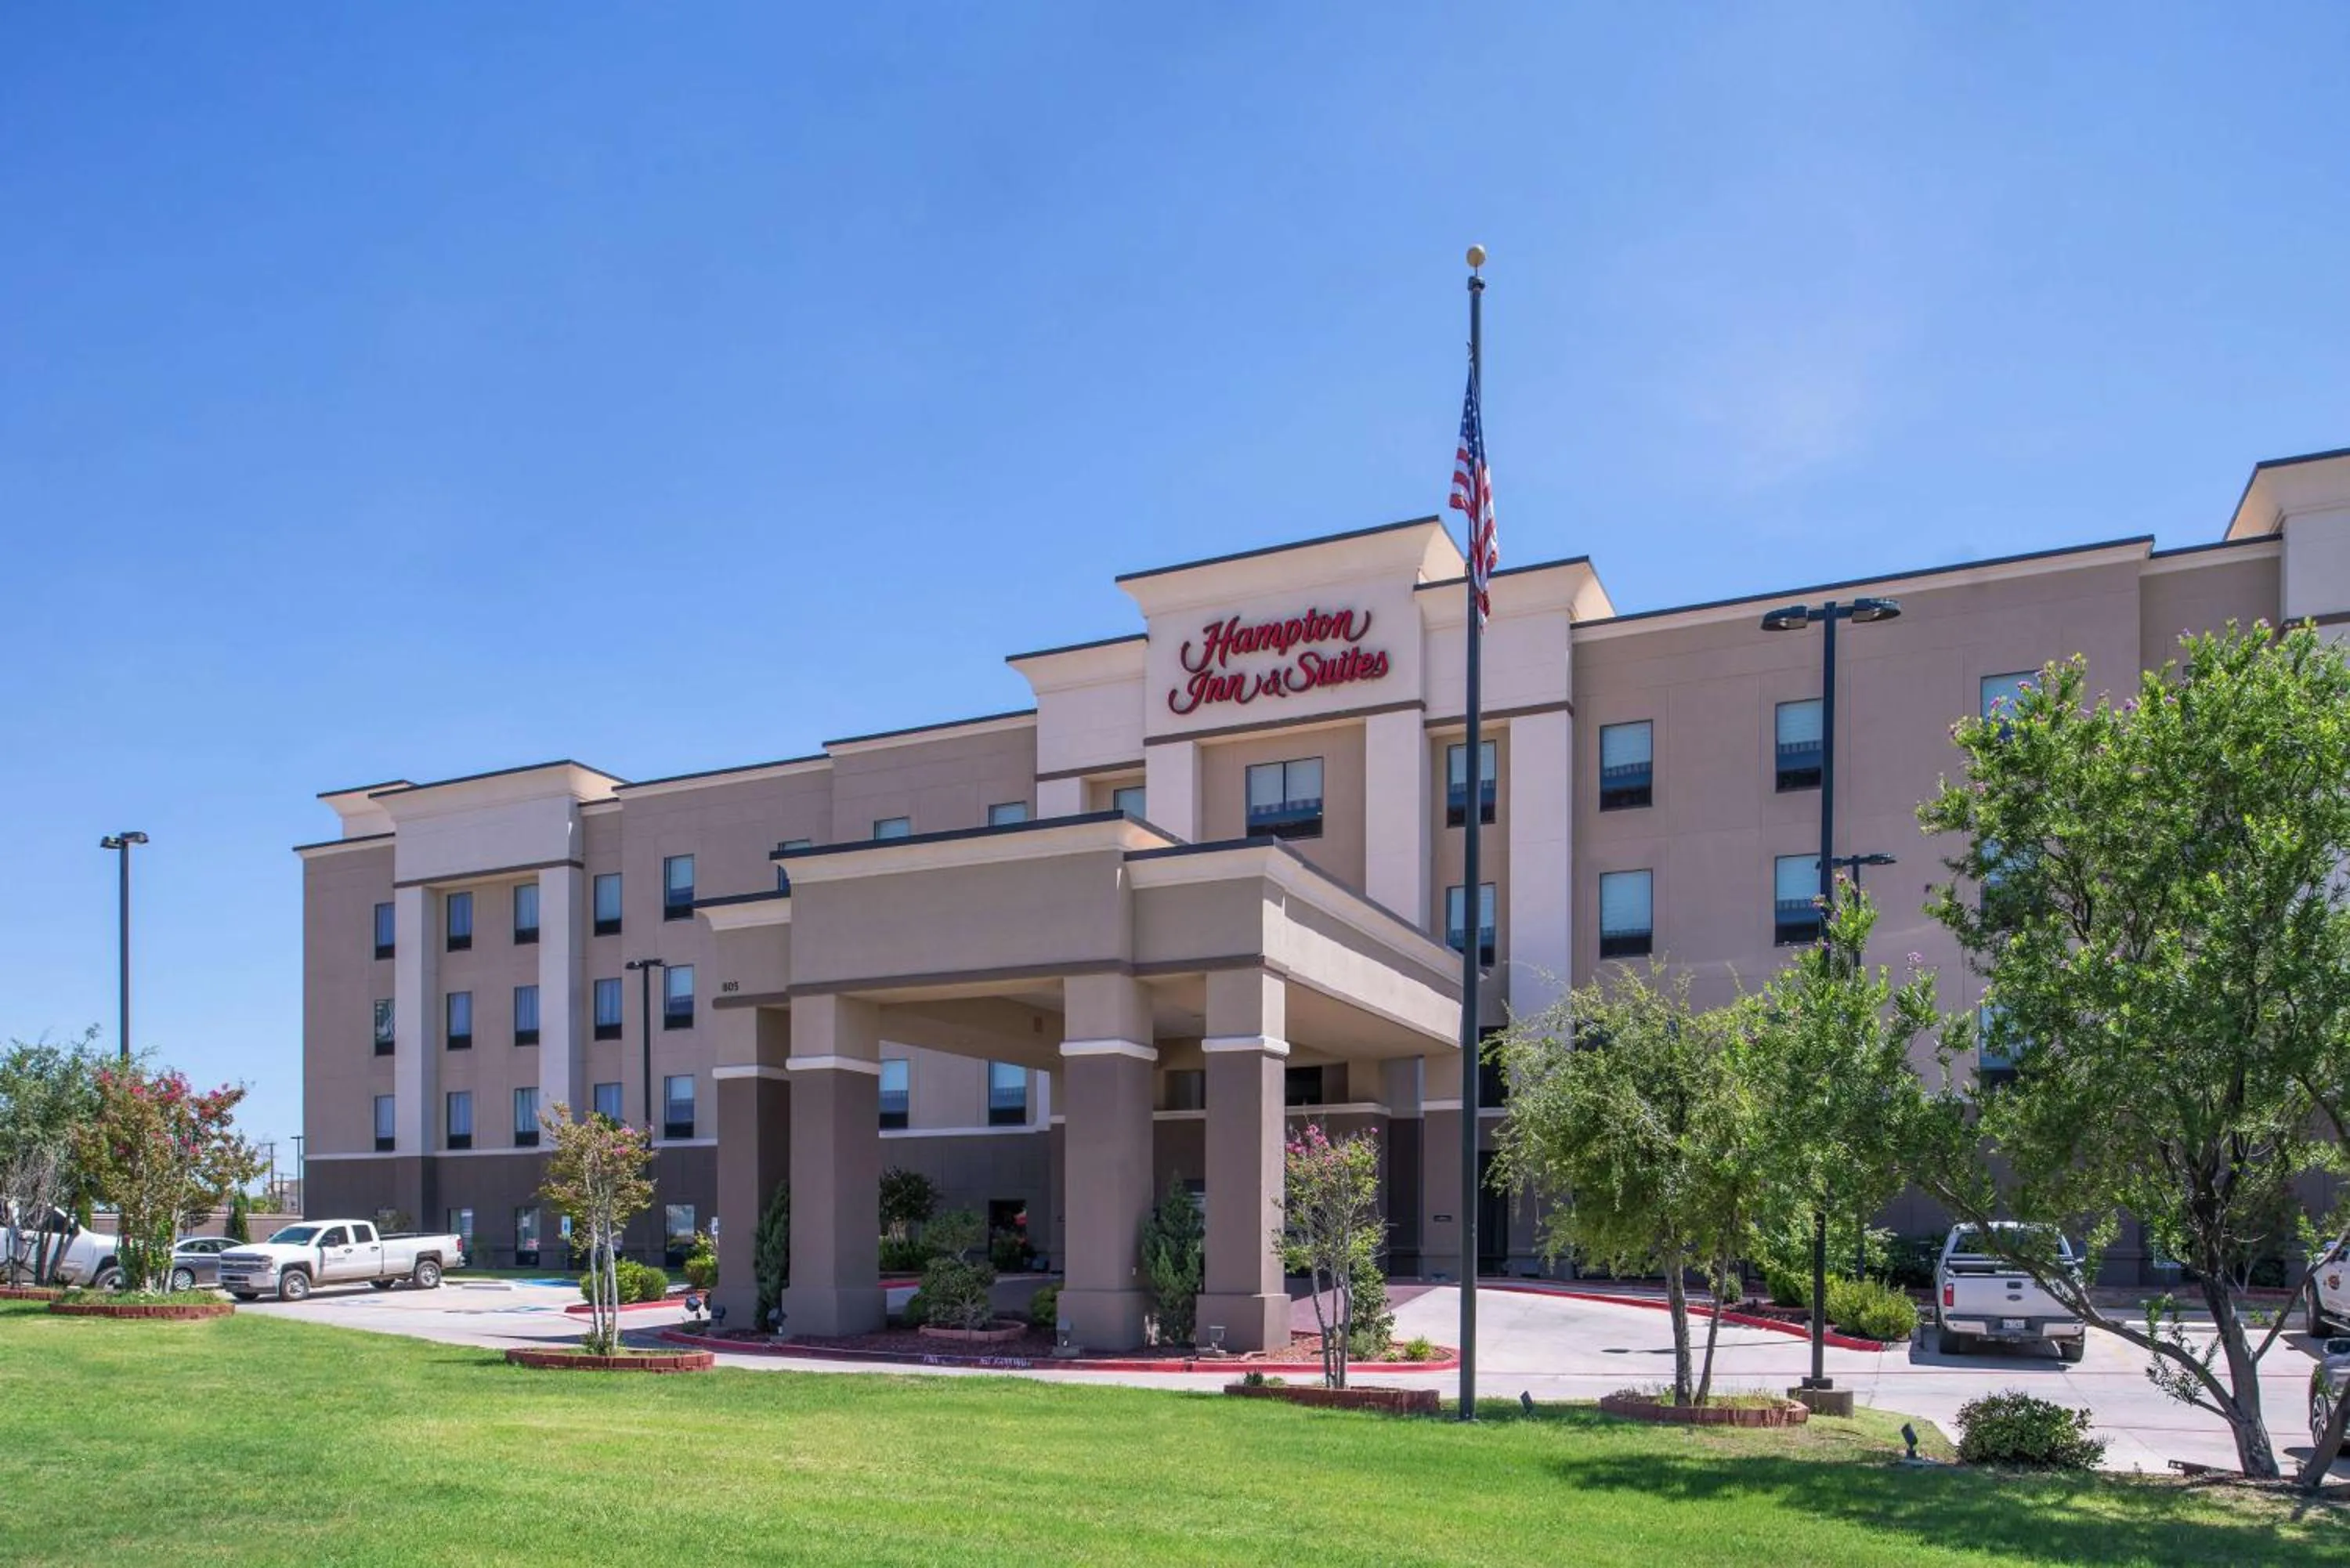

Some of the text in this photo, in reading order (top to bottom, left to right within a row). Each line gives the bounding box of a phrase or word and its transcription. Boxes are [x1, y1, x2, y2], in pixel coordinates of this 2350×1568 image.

[1180, 608, 1371, 673] Hampton
[1168, 647, 1389, 715] Inn & Suites
